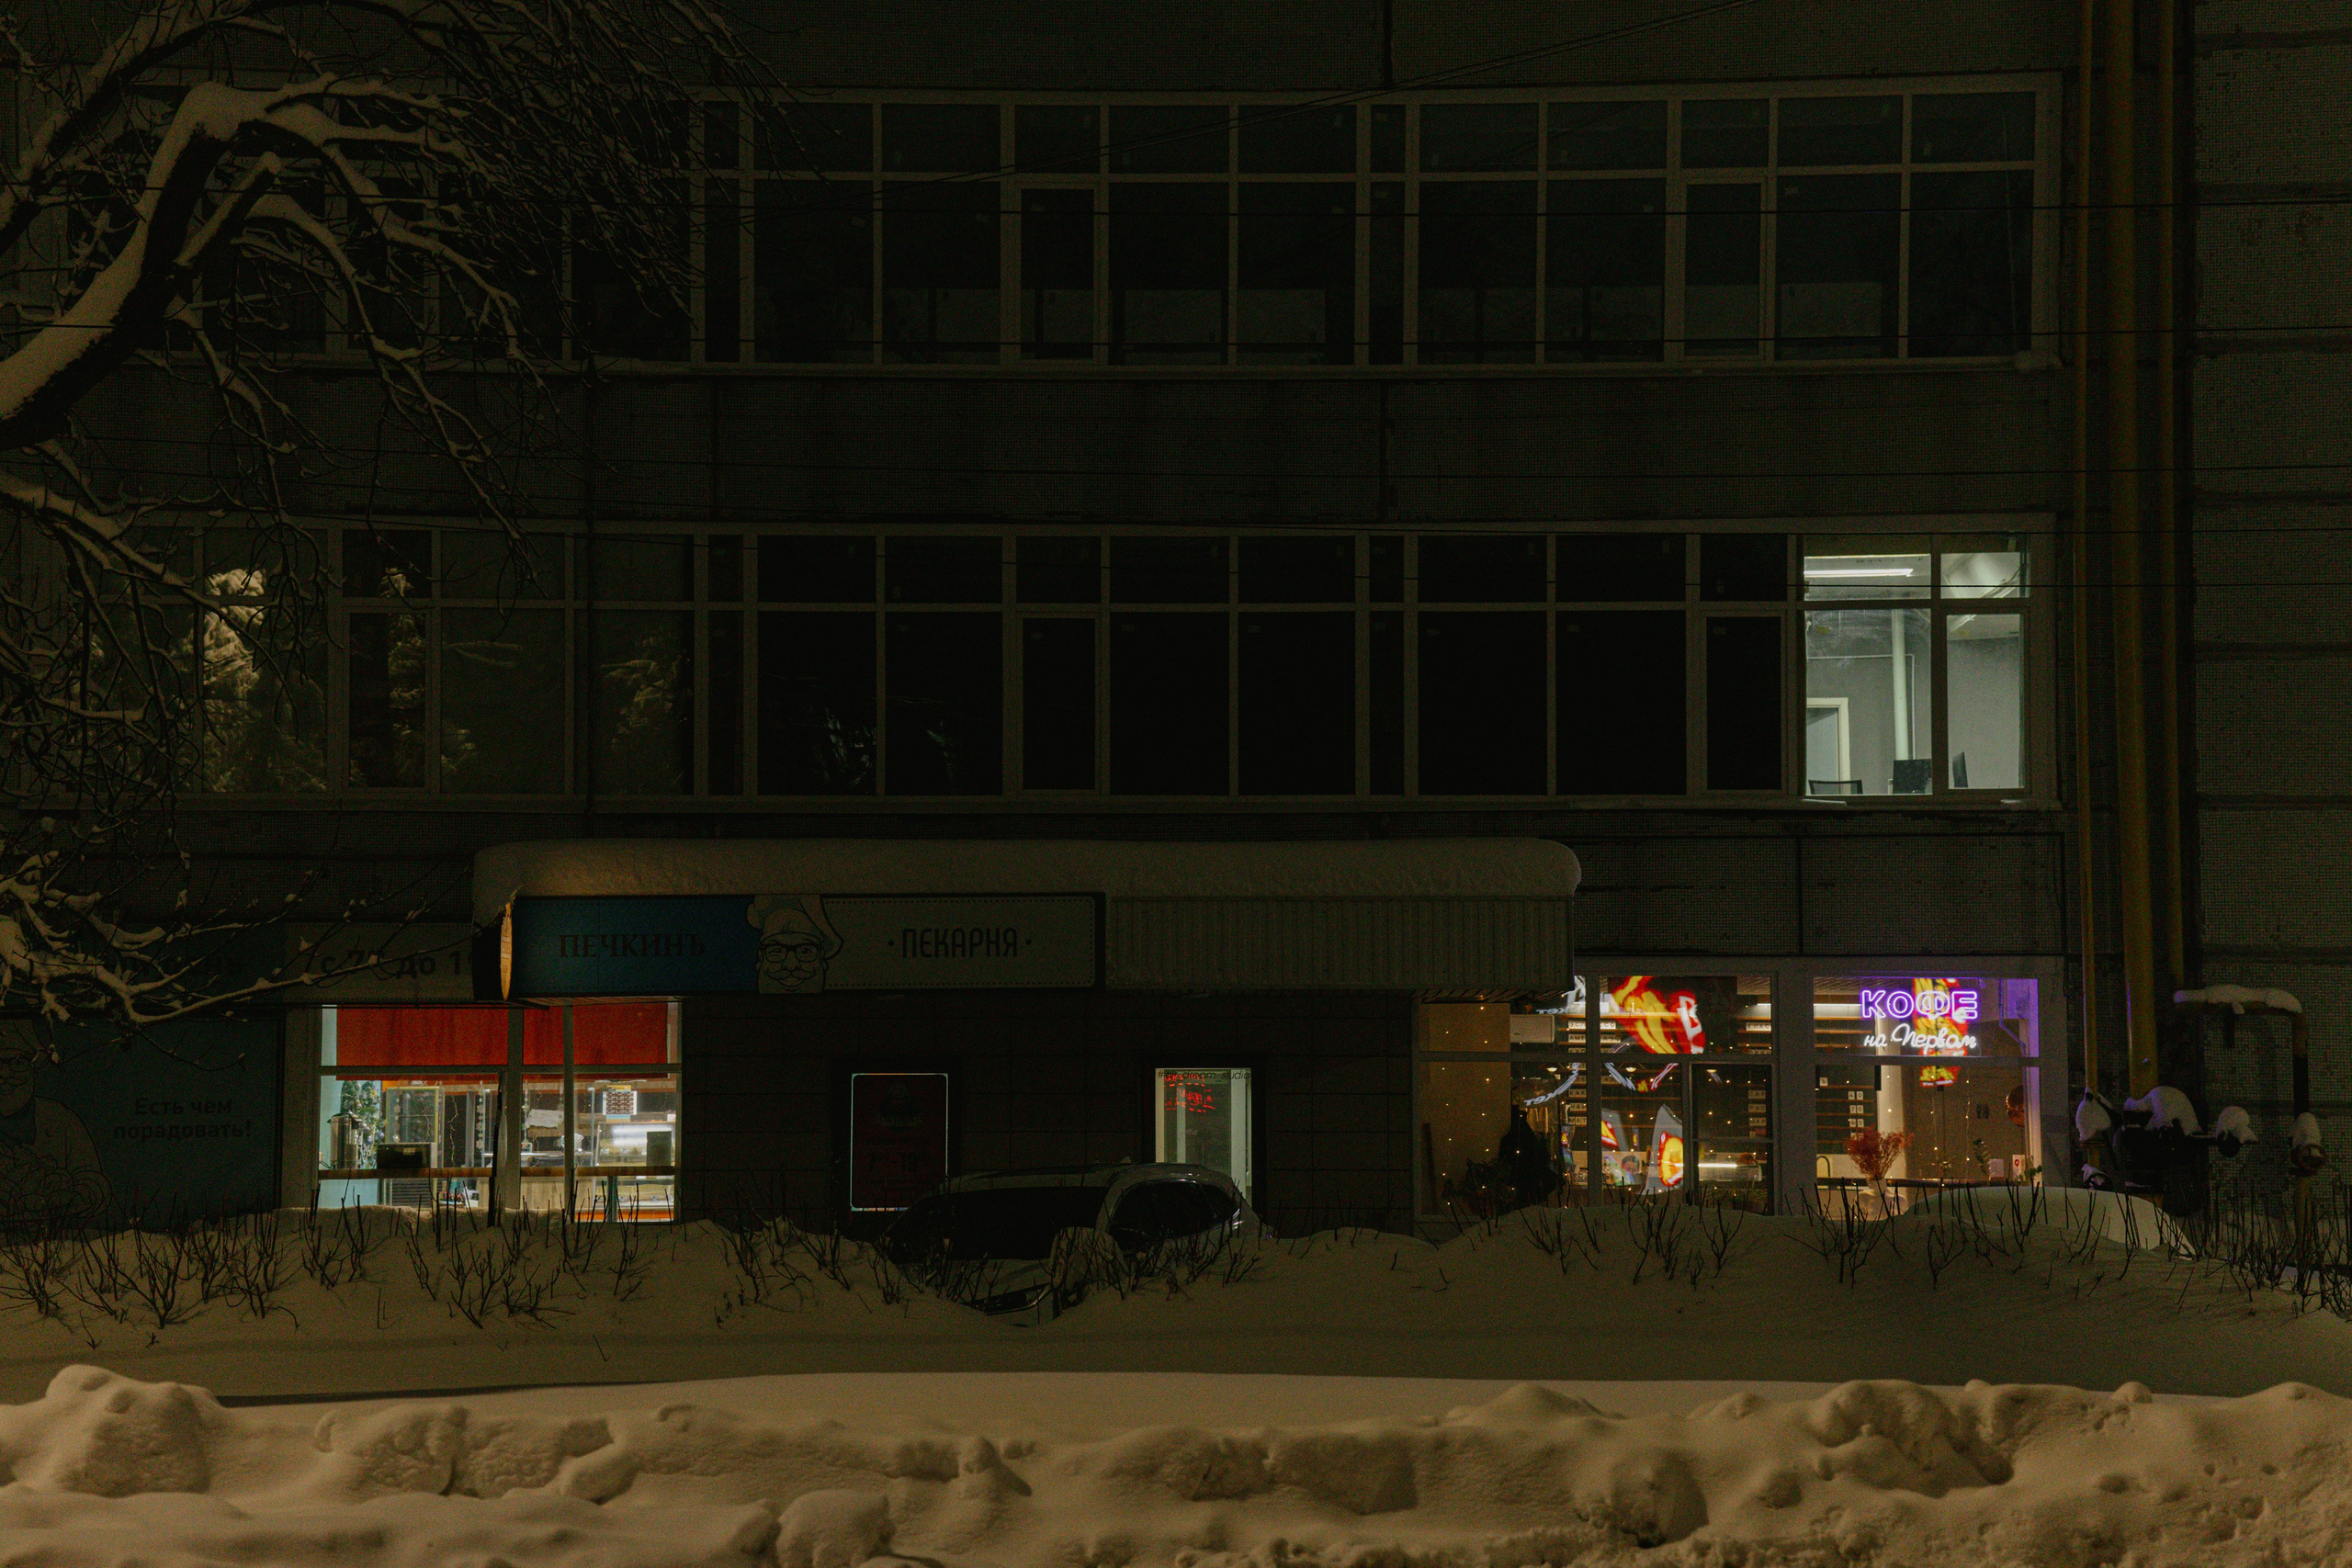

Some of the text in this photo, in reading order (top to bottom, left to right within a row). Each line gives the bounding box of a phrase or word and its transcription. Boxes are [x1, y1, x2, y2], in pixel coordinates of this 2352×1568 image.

[559, 932, 707, 958] ПЕЧКИНЪ
[902, 927, 1018, 958] ПЕКАРНЯ
[1860, 989, 1979, 1021] КОФЕ
[1863, 1022, 1977, 1056] на Первом
[134, 1097, 232, 1115] Есть чем
[113, 1119, 252, 1144] порадовать!
